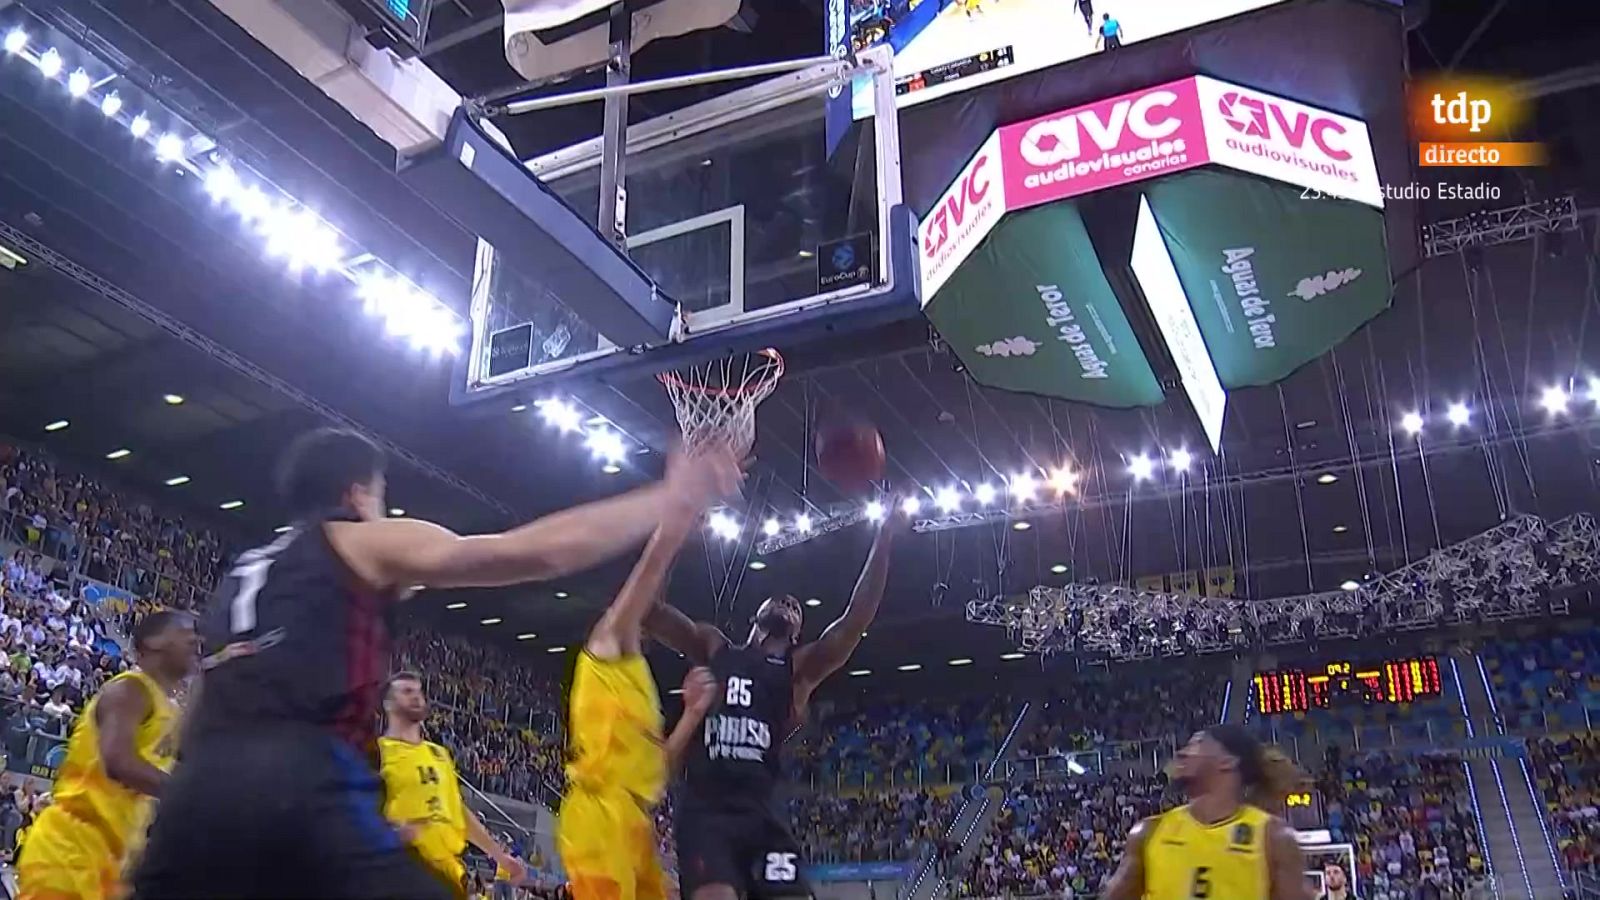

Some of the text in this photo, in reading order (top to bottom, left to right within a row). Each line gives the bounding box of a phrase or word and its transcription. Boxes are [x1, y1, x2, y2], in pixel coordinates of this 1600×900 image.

[1024, 138, 1186, 189] audiovisuales
[1123, 153, 1188, 177] canarias
[1225, 137, 1359, 183] audiovisuales
[925, 201, 993, 282] audiovisuales
[820, 271, 857, 285] EuroCup
[1221, 246, 1260, 298] Aguas
[1240, 296, 1271, 317] de
[1056, 323, 1087, 344] de
[1071, 343, 1109, 379] Aguas
[726, 676, 753, 707] 25
[415, 766, 439, 785] 14
[765, 852, 798, 881] 25
